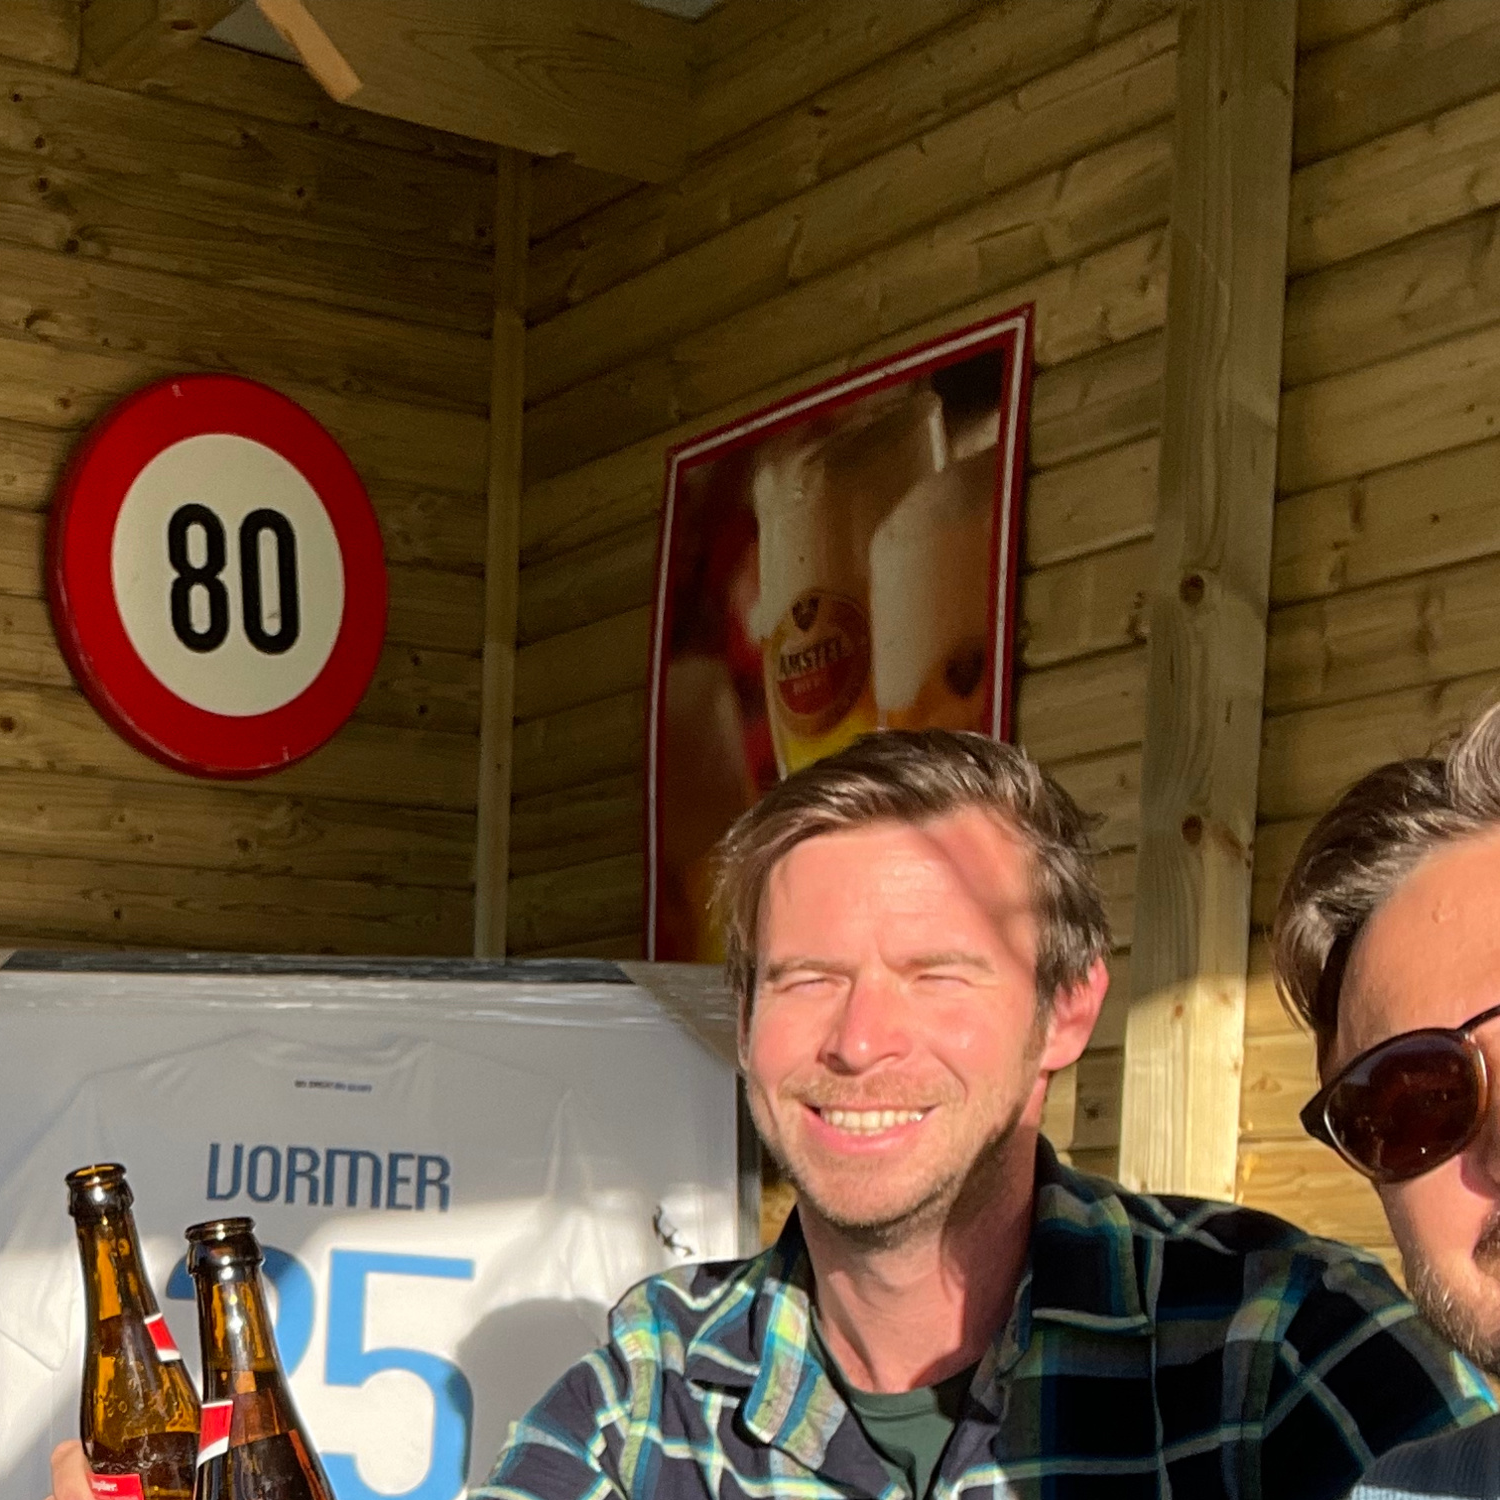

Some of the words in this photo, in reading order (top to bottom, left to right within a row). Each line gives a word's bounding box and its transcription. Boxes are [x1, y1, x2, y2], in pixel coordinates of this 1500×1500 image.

[167, 503, 300, 655] 80
[778, 635, 848, 679] AMSTEL
[207, 1142, 451, 1213] VORMER
